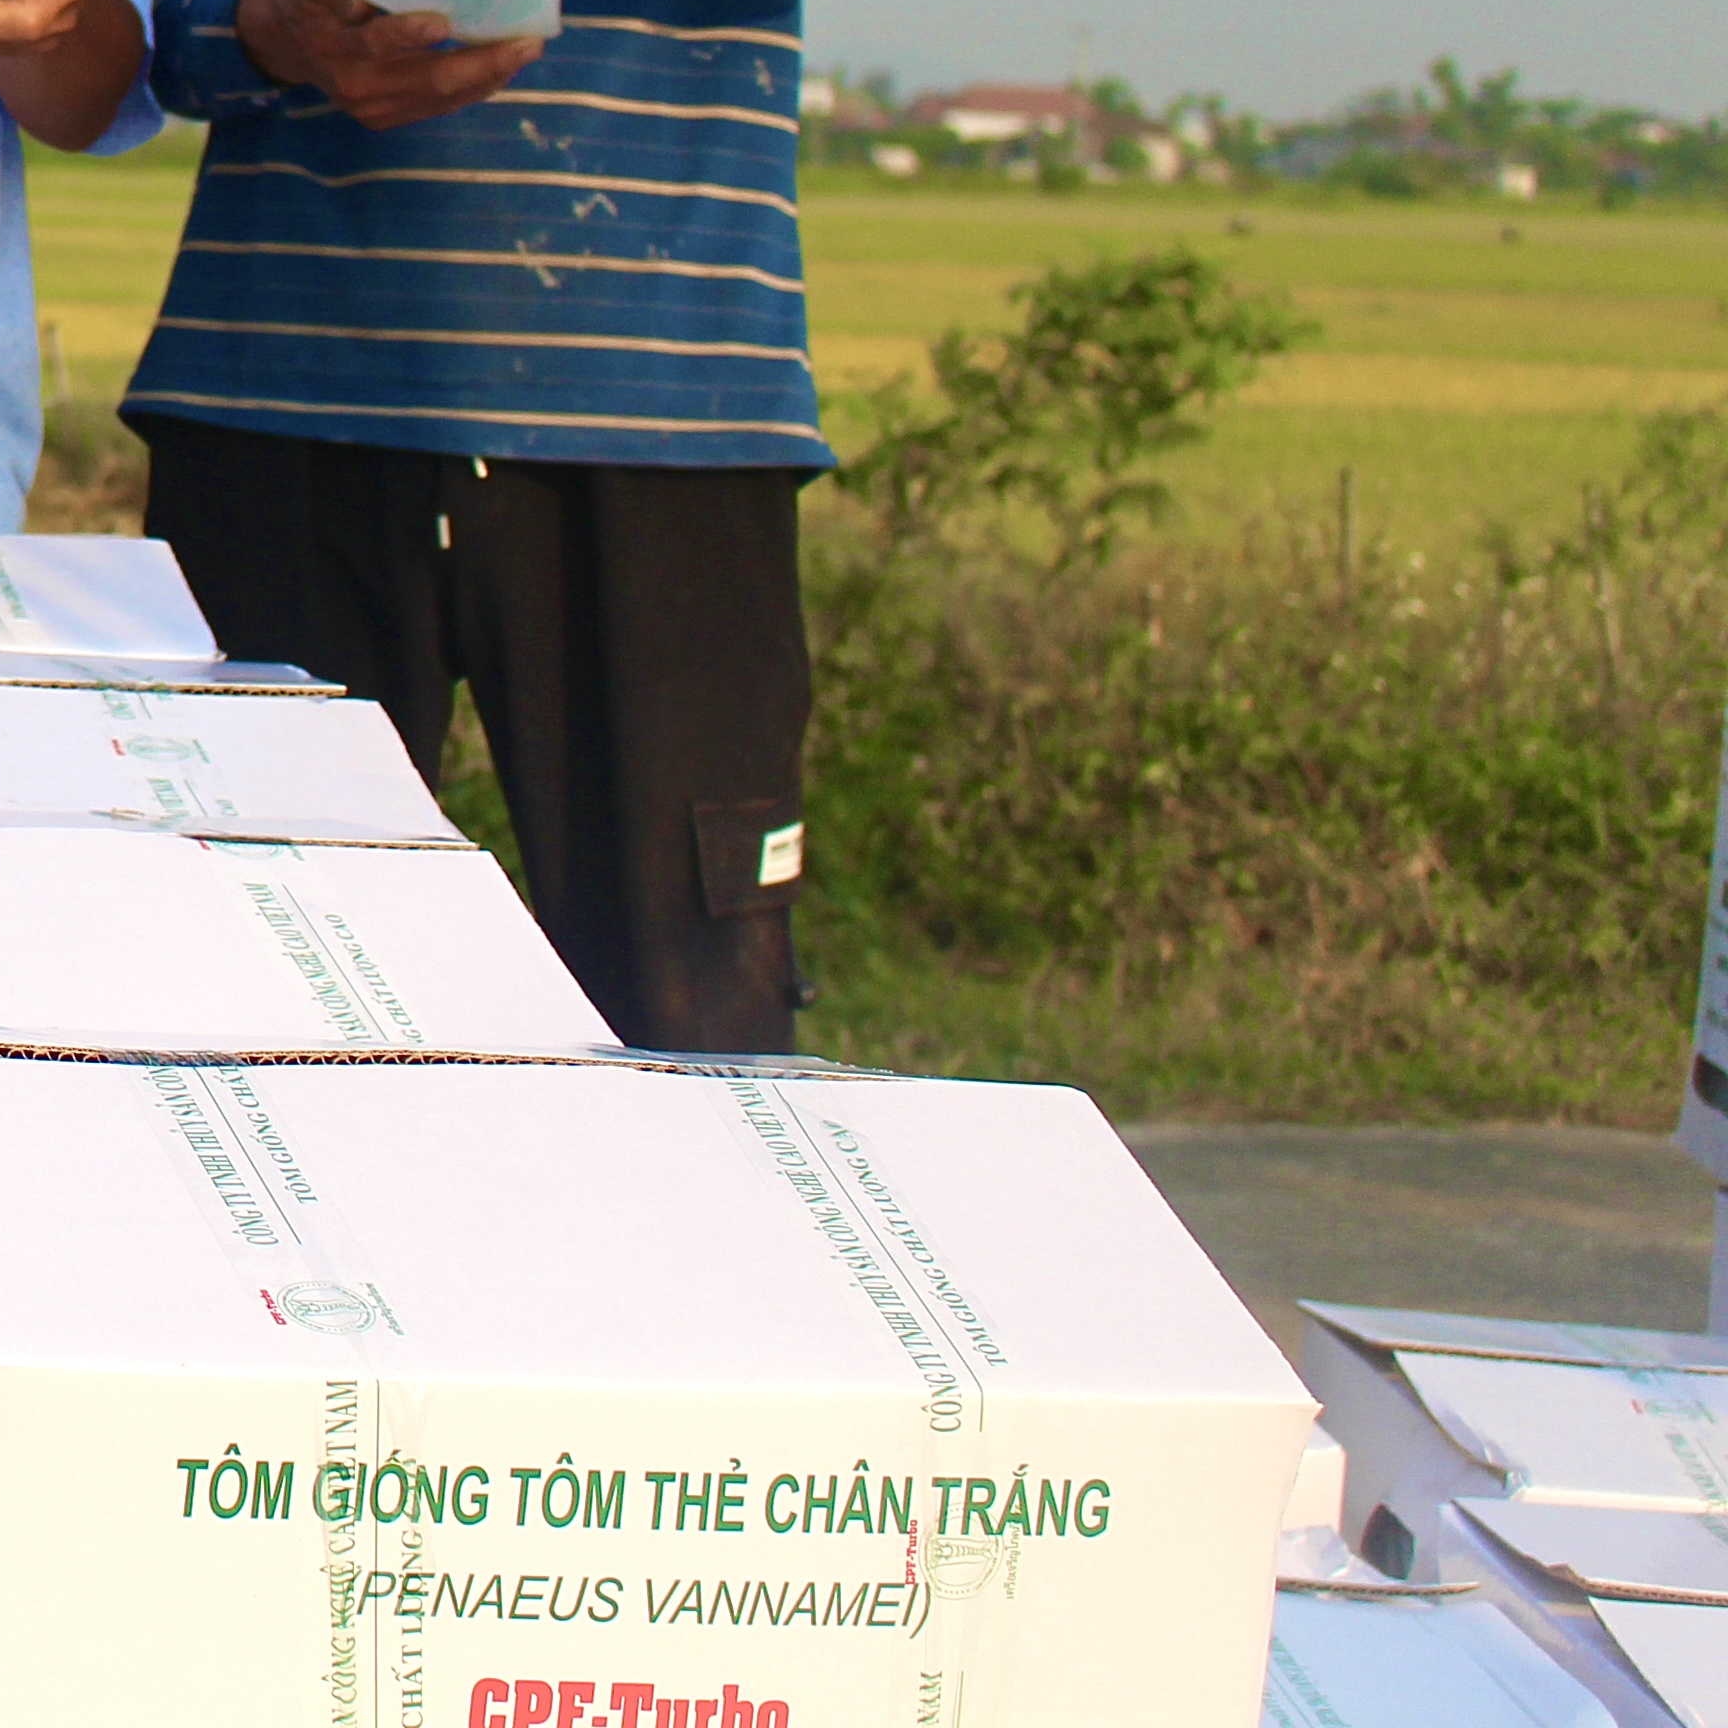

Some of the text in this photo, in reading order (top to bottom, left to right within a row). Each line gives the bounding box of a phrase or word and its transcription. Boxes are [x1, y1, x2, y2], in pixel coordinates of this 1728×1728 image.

[324, 913, 355, 940] CAO
[370, 988, 413, 1026] CHẤT
[142, 1066, 188, 1091] CÔN
[725, 1081, 770, 1109] NAM
[213, 1066, 319, 1204] TÔM GIỐNG CHẤT
[765, 1140, 808, 1167] CAO
[197, 1153, 247, 1188] TNHH
[846, 1156, 902, 1215] LƯỢNG
[218, 1190, 257, 1208] TY
[231, 1209, 280, 1246] CÔNG
[809, 1206, 860, 1242] CÔNG
[882, 1217, 935, 1265] CHẤT
[923, 1267, 978, 1324] GIỐNG
[879, 1310, 934, 1348] TNHH
[964, 1325, 1010, 1367] TÔM
[907, 1349, 948, 1370] TY
[325, 1378, 359, 1434] NAM
[920, 1372, 963, 1433] CÔNG
[175, 1442, 1112, 1539] TÔM GIỐNG TÔM THẺ CHÂN TRẮNG
[905, 1519, 918, 1585] CPF-Turbo
[339, 1570, 932, 1639] (PENAEUS VANNAMEI)
[467, 1677, 791, 1728] CPF-Turbo
